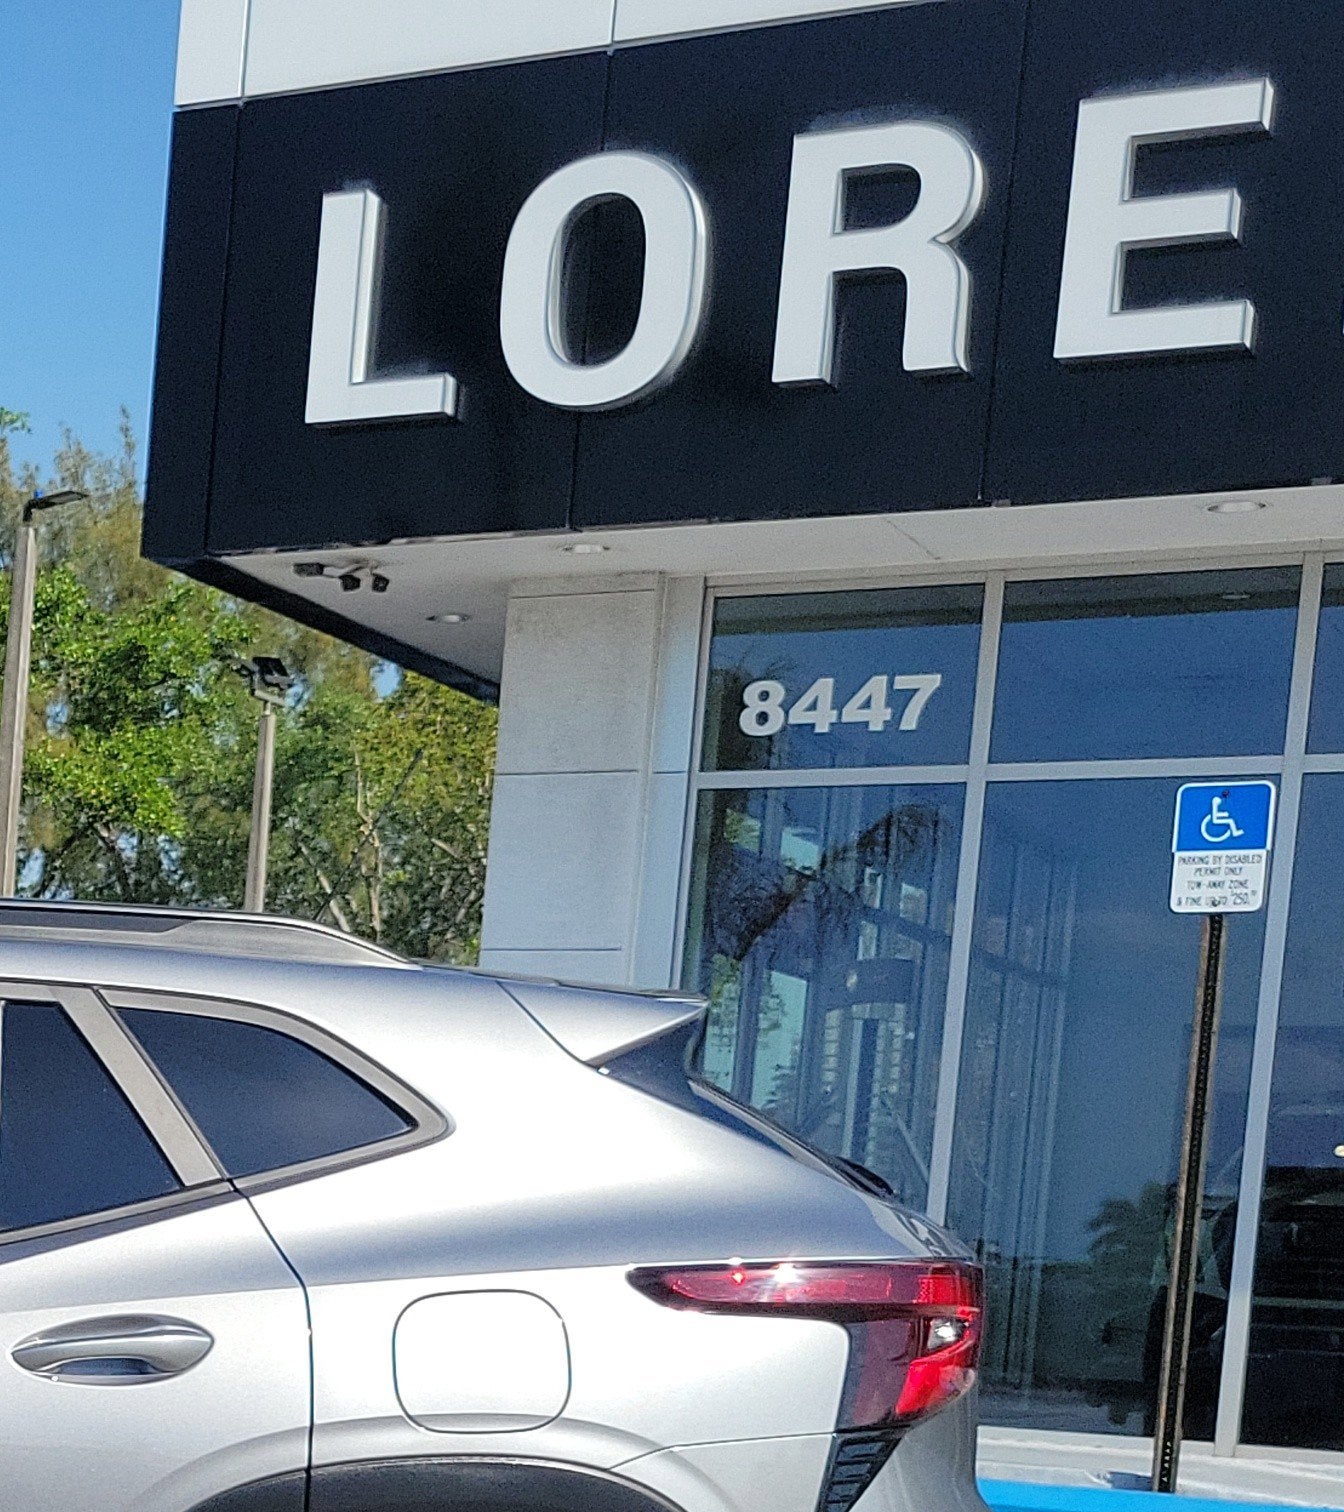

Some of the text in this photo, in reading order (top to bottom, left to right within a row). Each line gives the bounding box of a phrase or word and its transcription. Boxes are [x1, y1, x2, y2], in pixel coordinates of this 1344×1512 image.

[305, 77, 1275, 425] LORE
[739, 673, 942, 737] 8447
[1177, 855, 1209, 866] PARKING
[1225, 854, 1263, 864] DISABLED
